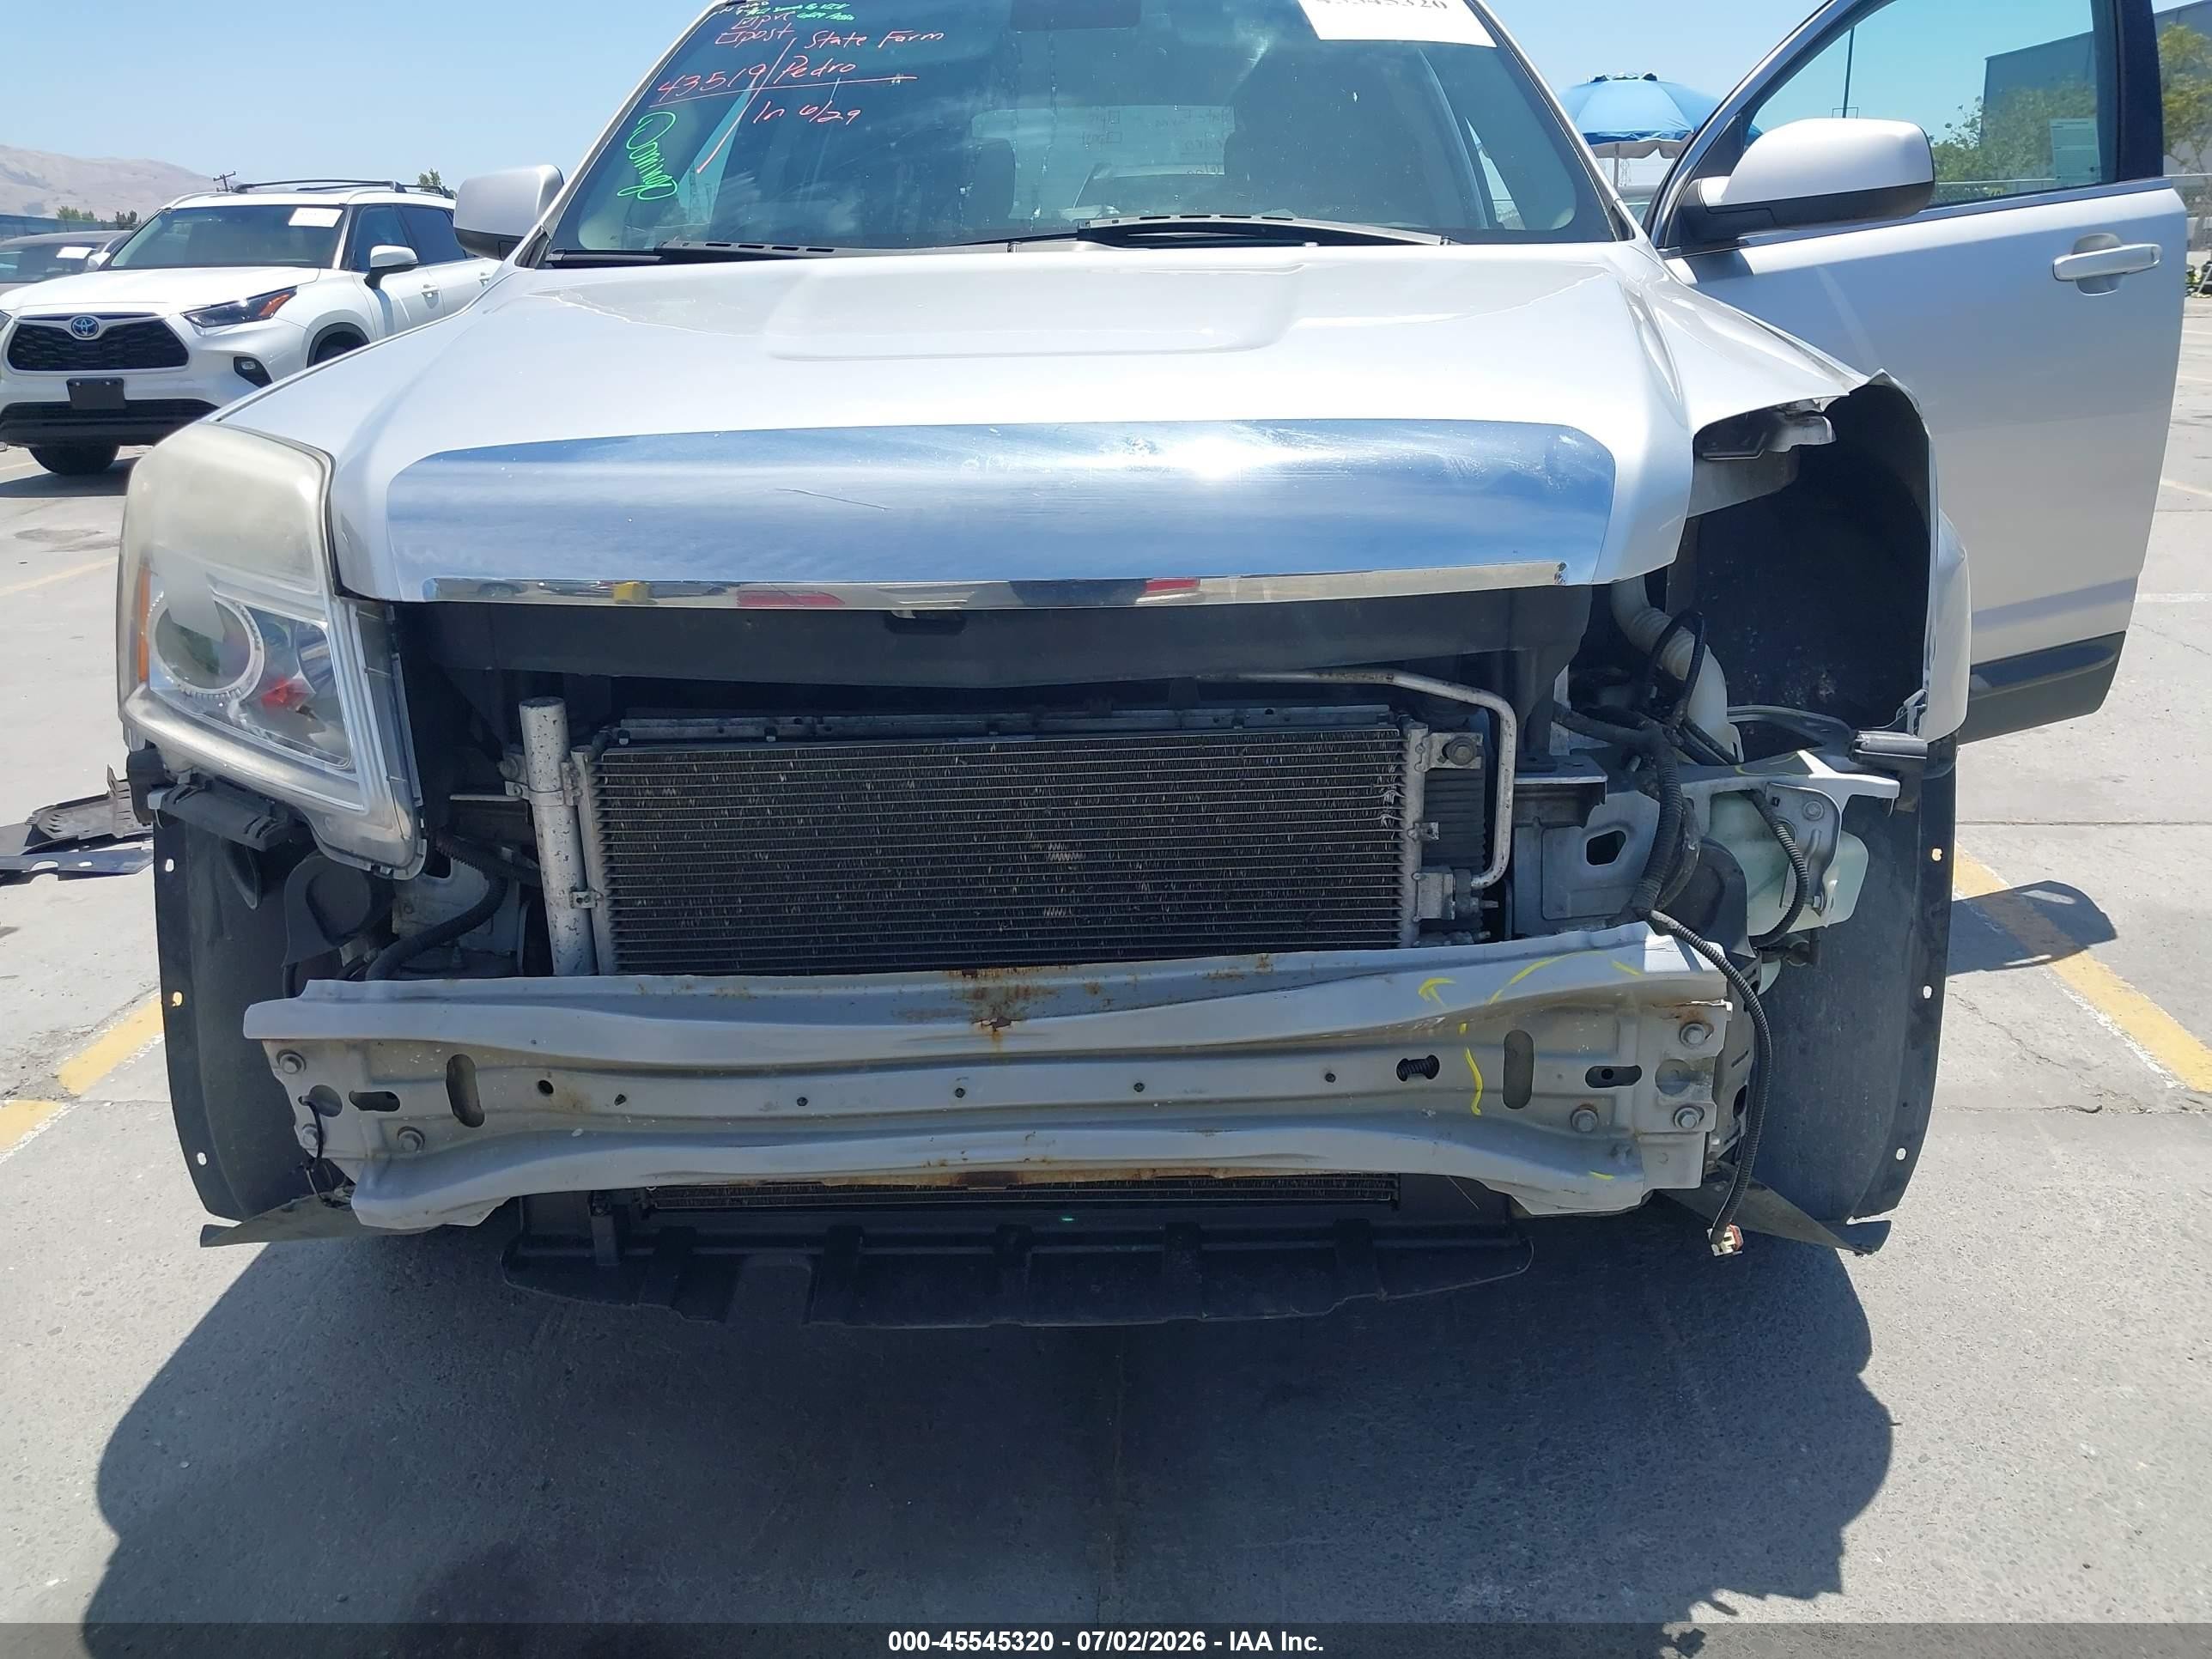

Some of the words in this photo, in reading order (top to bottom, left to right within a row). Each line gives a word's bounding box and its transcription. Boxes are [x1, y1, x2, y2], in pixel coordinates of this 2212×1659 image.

[804, 30, 868, 49] State
[877, 30, 945, 49] Farm
[658, 64, 767, 102] 43519
[774, 55, 857, 84] Pedro
[799, 100, 862, 125] 6/29
